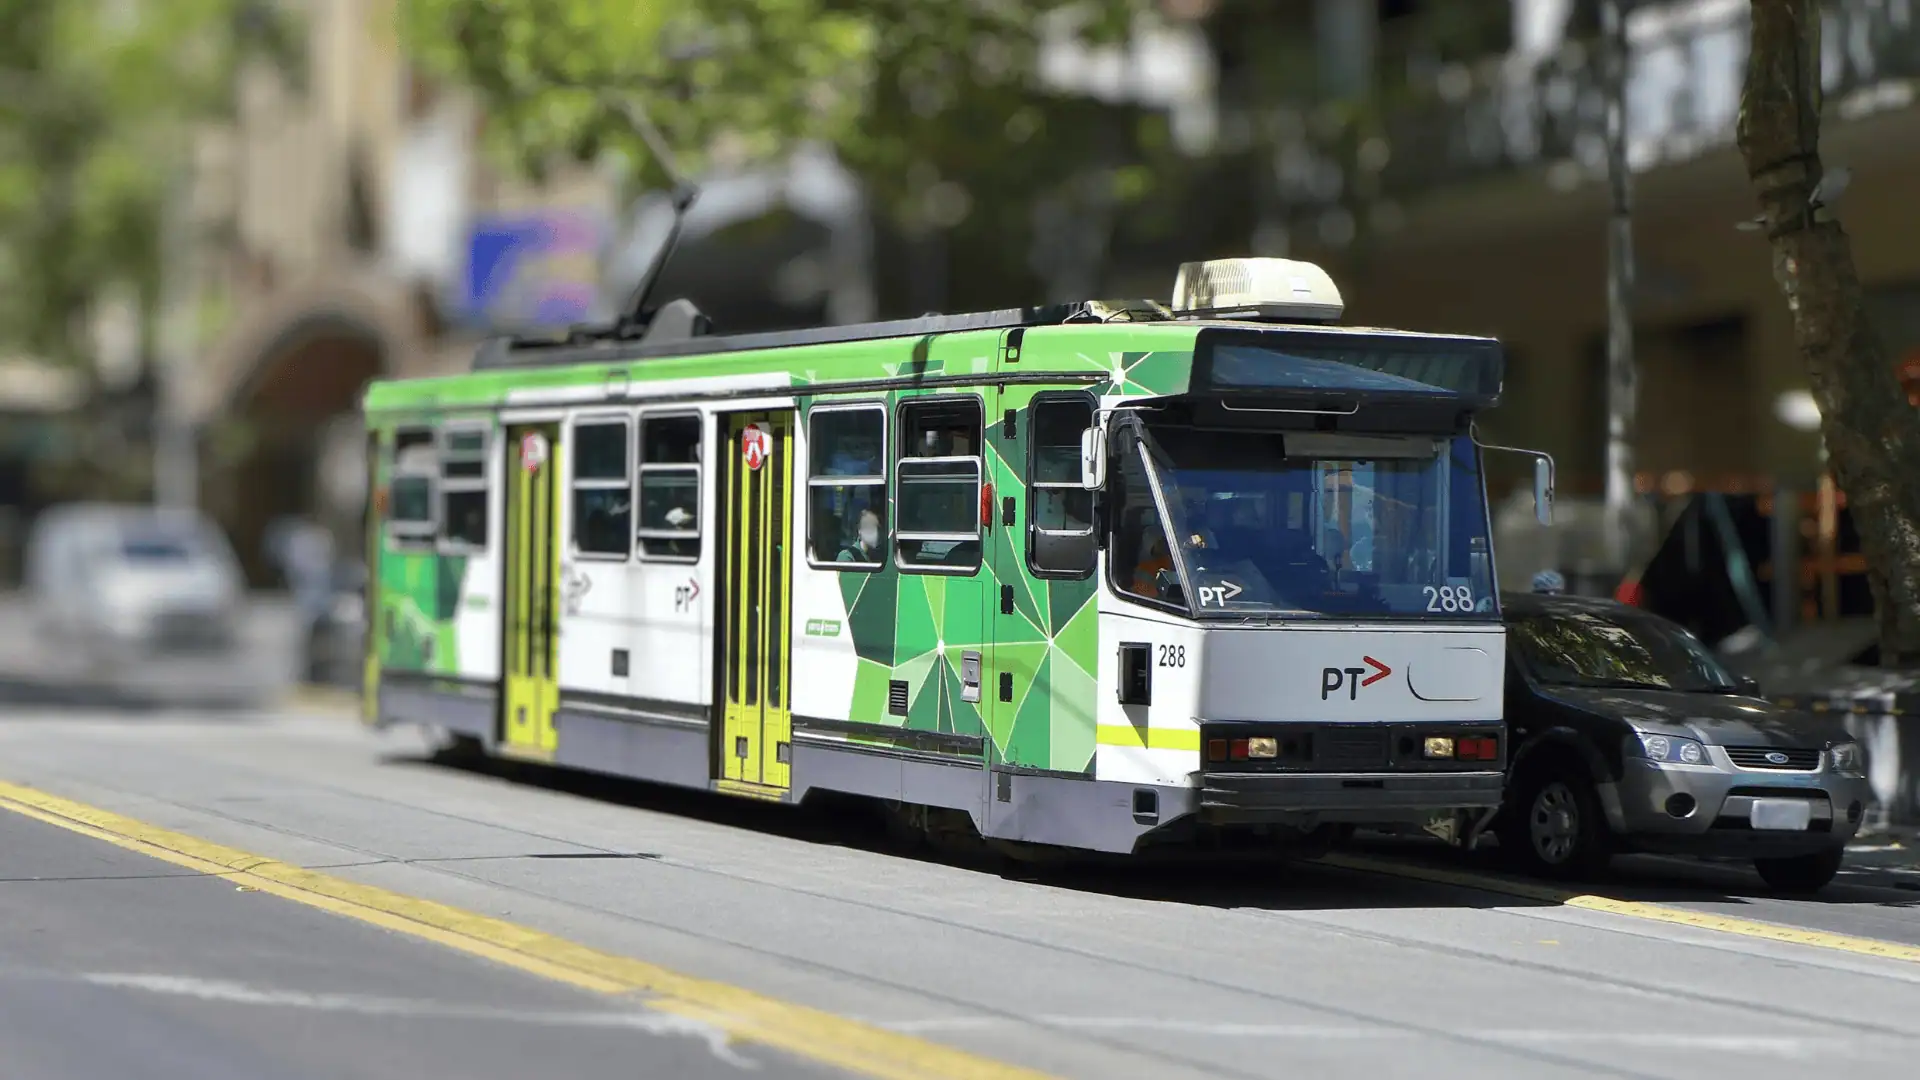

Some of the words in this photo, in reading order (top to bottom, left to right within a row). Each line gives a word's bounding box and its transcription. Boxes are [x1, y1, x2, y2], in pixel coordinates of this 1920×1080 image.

[1199, 587, 1226, 607] PT
[1423, 586, 1475, 613] 288
[1159, 644, 1186, 668] 288
[1321, 667, 1366, 701] PT
